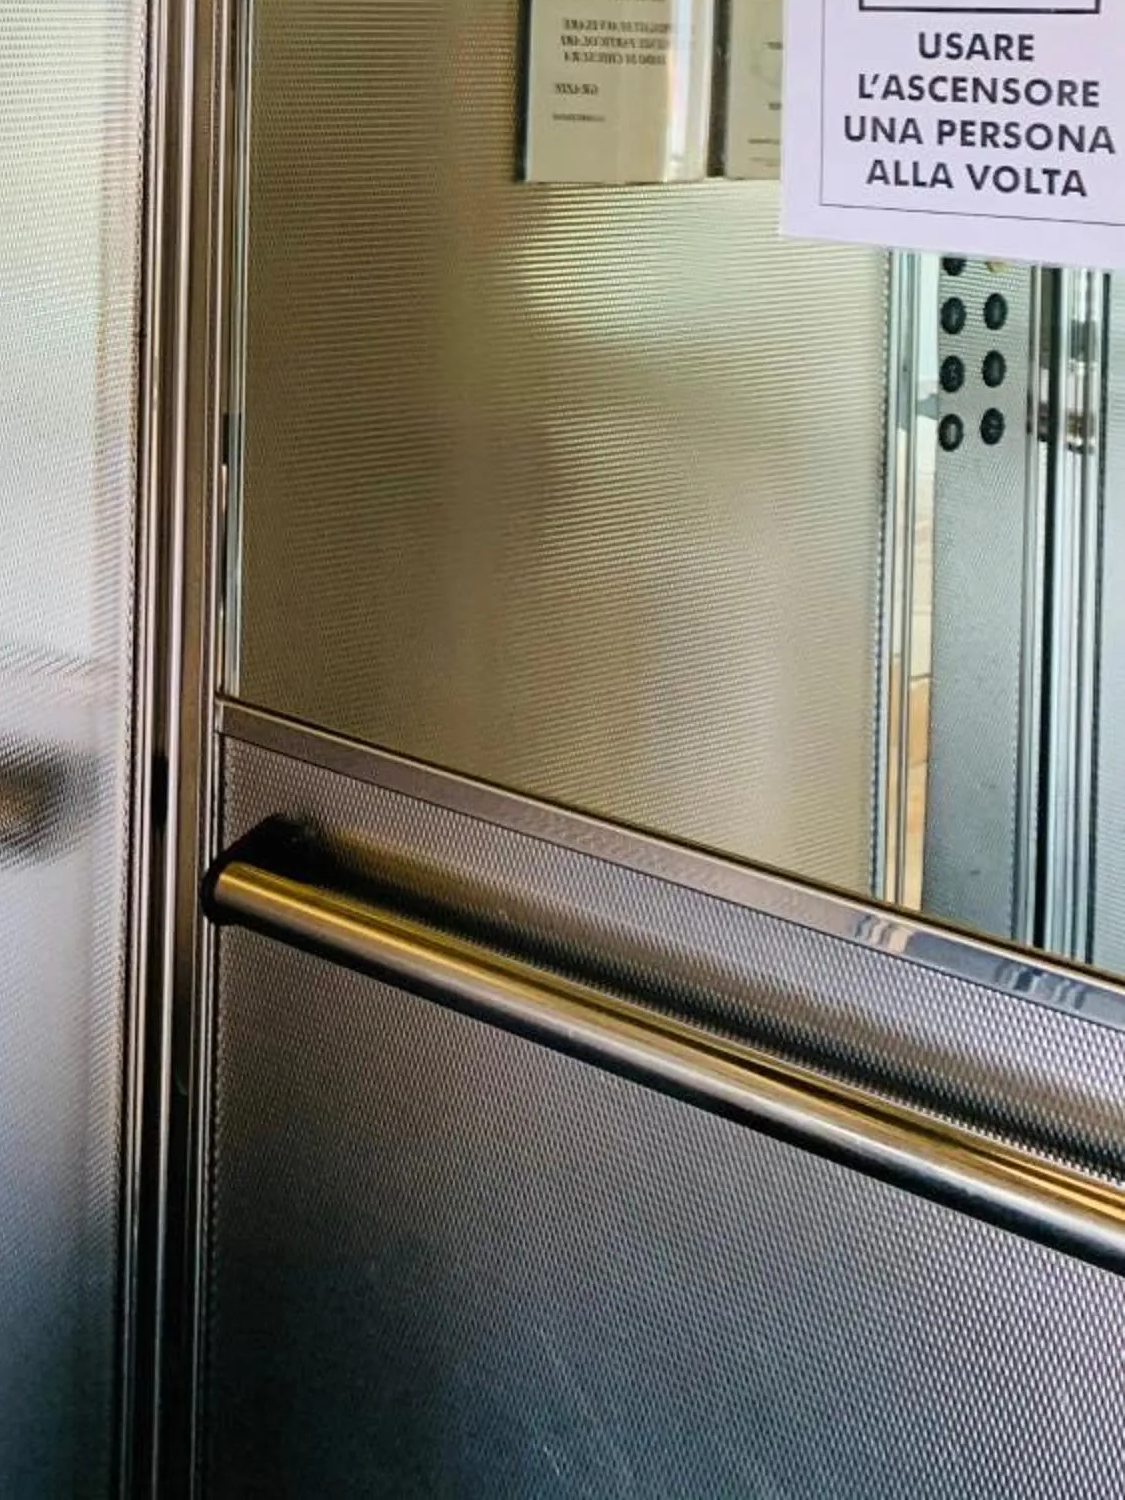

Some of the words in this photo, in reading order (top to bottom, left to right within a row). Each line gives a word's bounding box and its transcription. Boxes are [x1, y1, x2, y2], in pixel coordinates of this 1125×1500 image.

[918, 32, 1035, 62] USARE
[858, 73, 1100, 108] L'ASCENSORE
[844, 115, 924, 145] UNA
[936, 119, 1116, 155] PERSONA
[866, 159, 955, 190] ALLA
[966, 163, 1087, 197] VOLTA
